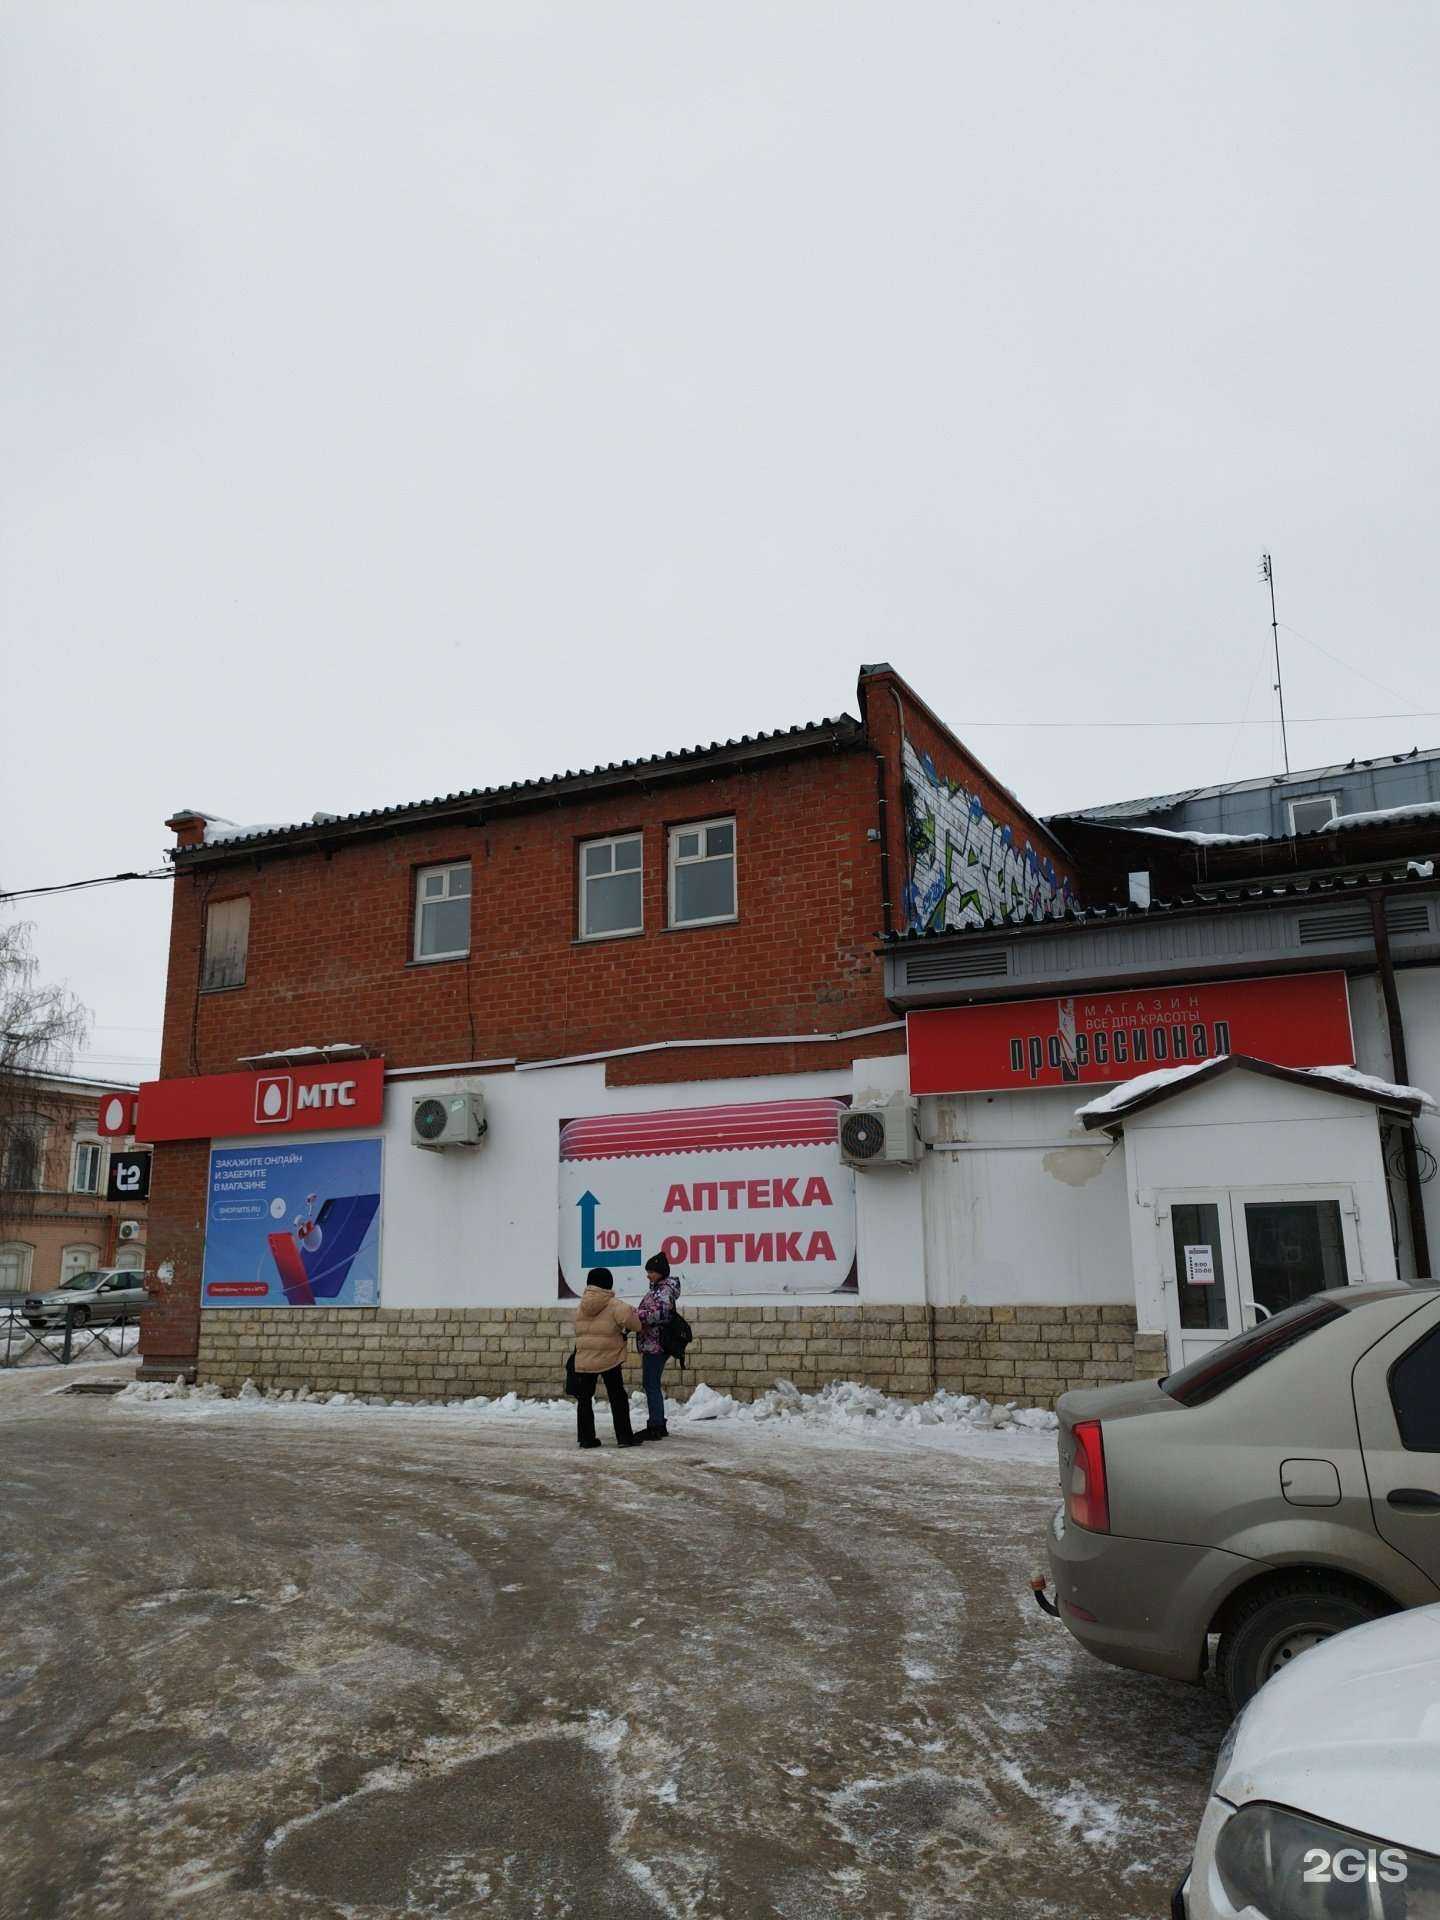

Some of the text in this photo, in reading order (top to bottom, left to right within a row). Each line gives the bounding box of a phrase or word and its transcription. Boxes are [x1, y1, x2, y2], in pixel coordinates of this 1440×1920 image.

[1085, 996, 1200, 1017] МАГАЗИН
[1086, 1010, 1200, 1030] ВСЕ ДЛЯ КРАСОТЫ
[297, 1081, 356, 1110] МТС
[215, 1153, 303, 1169] ЗАКАЖИТЕ ОНЛАЙН
[116, 1162, 141, 1191] t2
[215, 1168, 267, 1180] И ЗАБЕРИТЕ
[213, 1180, 267, 1192] В МАГАЗИНЕ
[663, 1176, 834, 1213] АПТЕКА
[596, 1229, 620, 1250] 10
[660, 1230, 837, 1266] ОПТИКА
